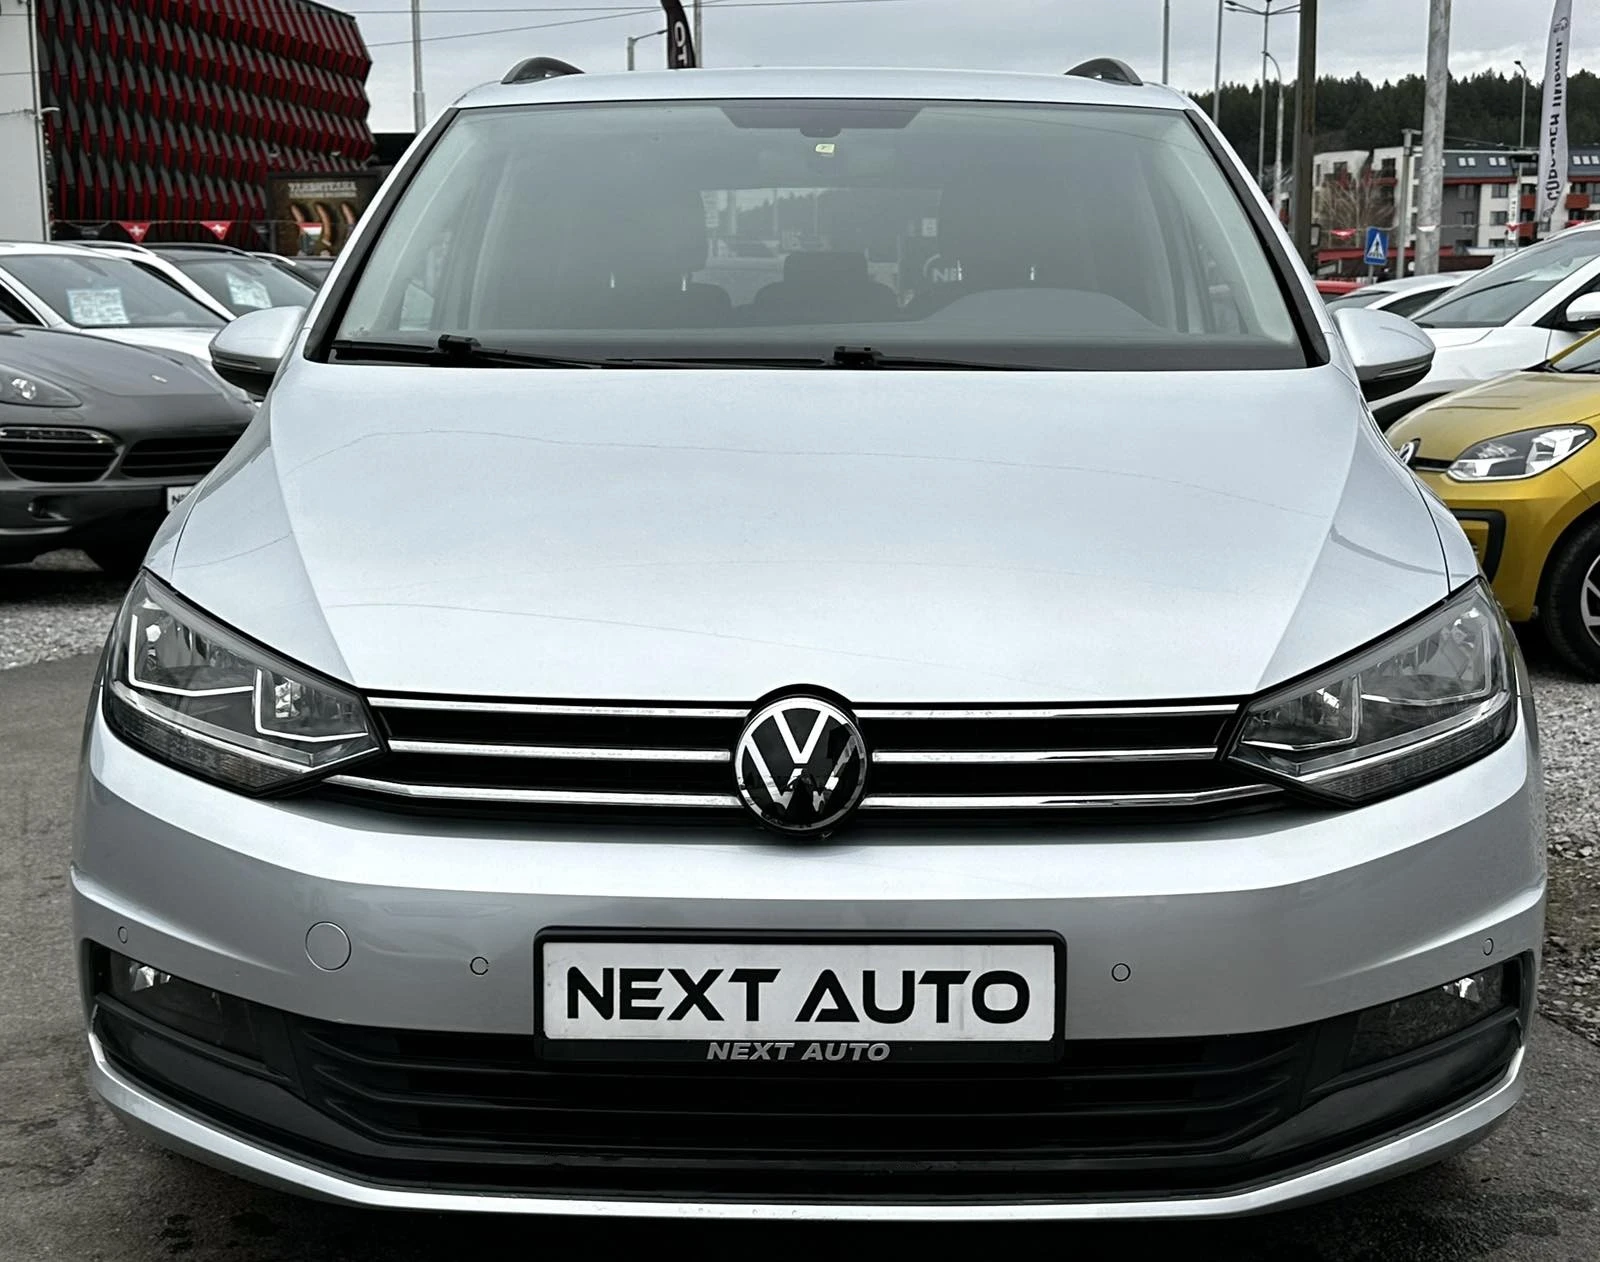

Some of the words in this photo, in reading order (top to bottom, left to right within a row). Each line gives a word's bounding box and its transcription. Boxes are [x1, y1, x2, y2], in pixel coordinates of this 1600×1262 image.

[566, 965, 782, 1022] NEXT
[795, 967, 1031, 1025] AUTO
[706, 1041, 795, 1061] NEXT
[800, 1042, 891, 1062] AUTO
